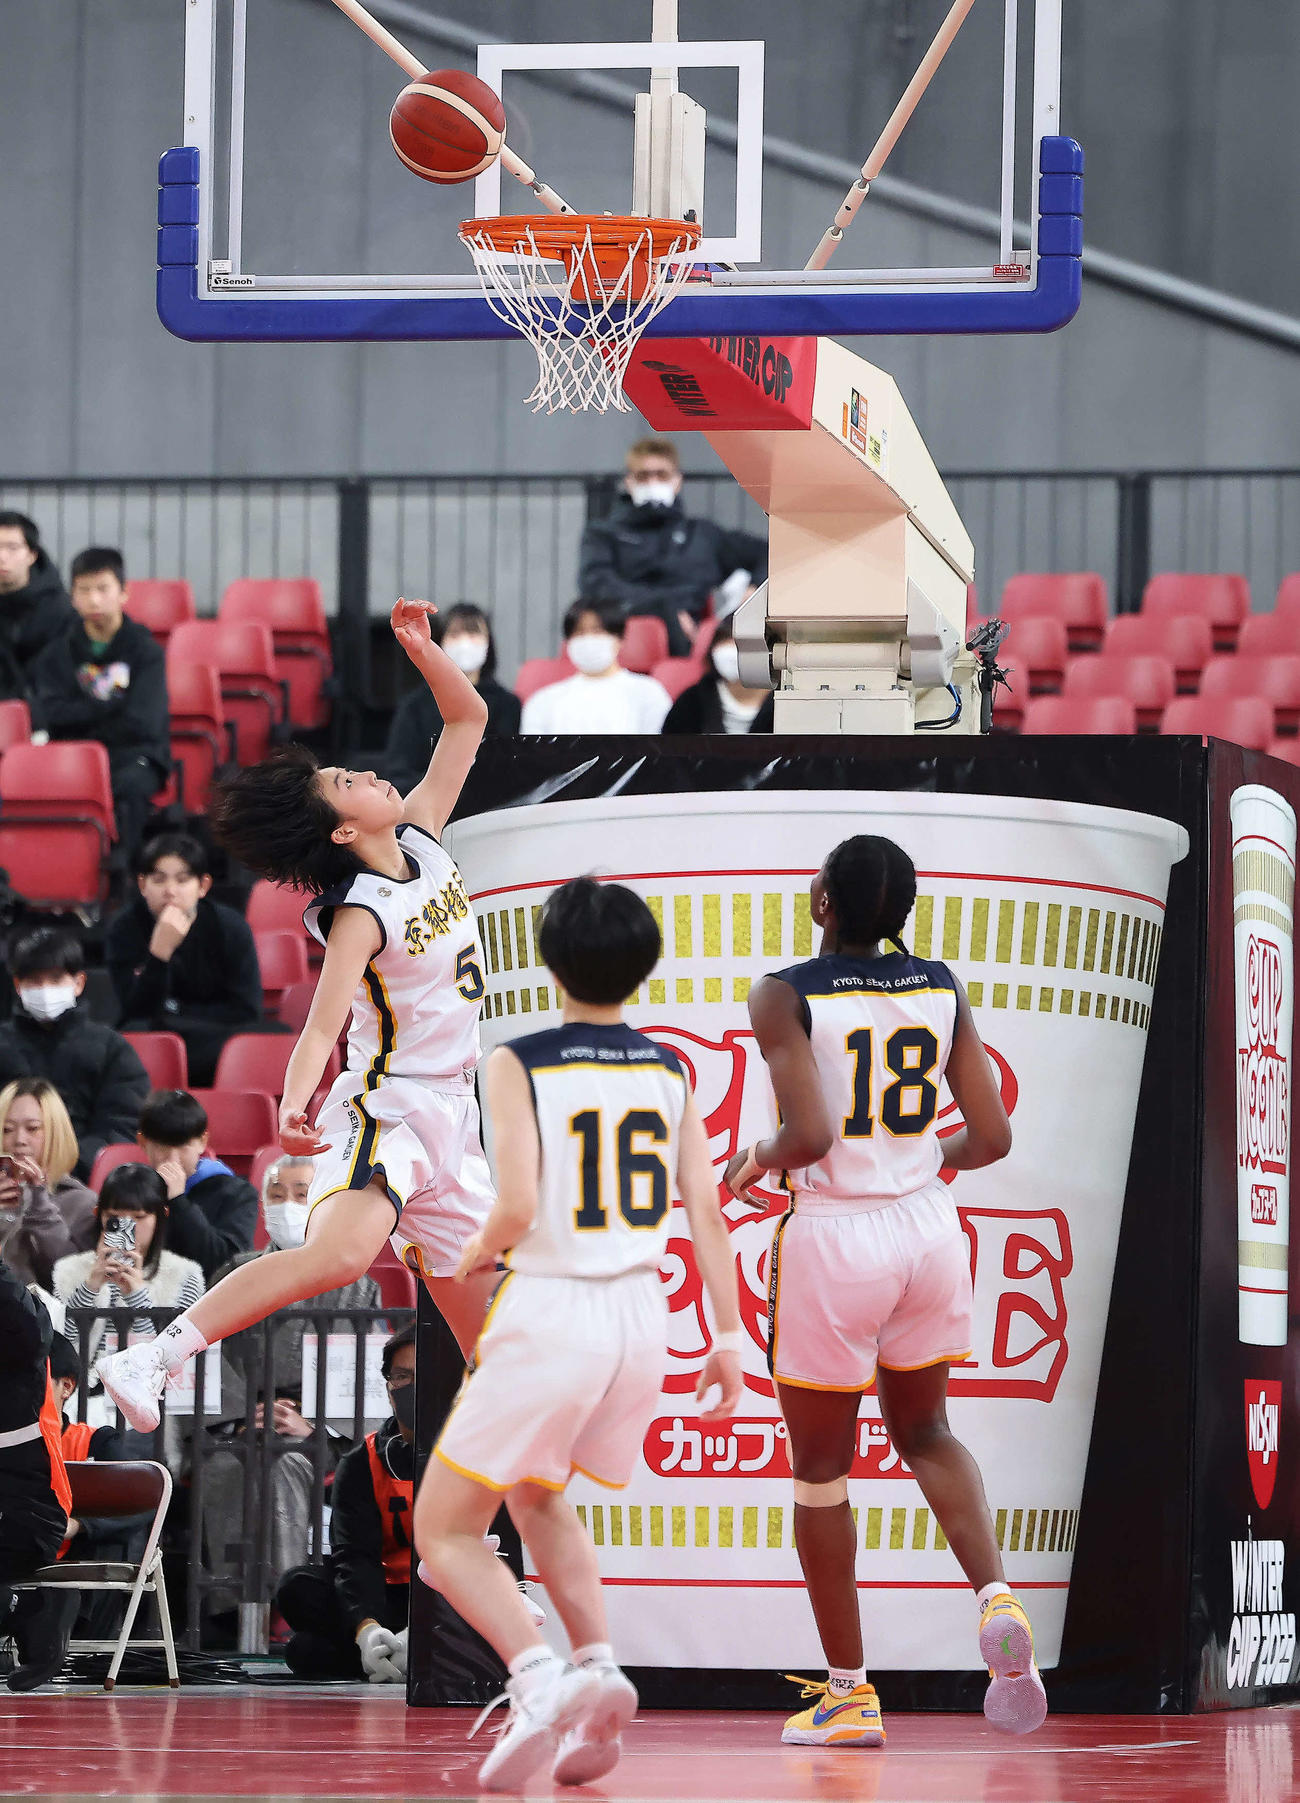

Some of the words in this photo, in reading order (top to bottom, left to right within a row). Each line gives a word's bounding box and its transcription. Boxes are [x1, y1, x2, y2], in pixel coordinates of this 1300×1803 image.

[762, 345, 793, 403] CUP
[455, 942, 486, 1003] 5
[832, 977, 864, 988] KYOTO
[894, 973, 929, 988] GAKUEN
[1246, 933, 1282, 1051] CUP
[841, 1025, 940, 1138] 18
[568, 1107, 670, 1232] 16
[1249, 1391, 1278, 1464] NISSIN
[1226, 1614, 1260, 1690] CUP
